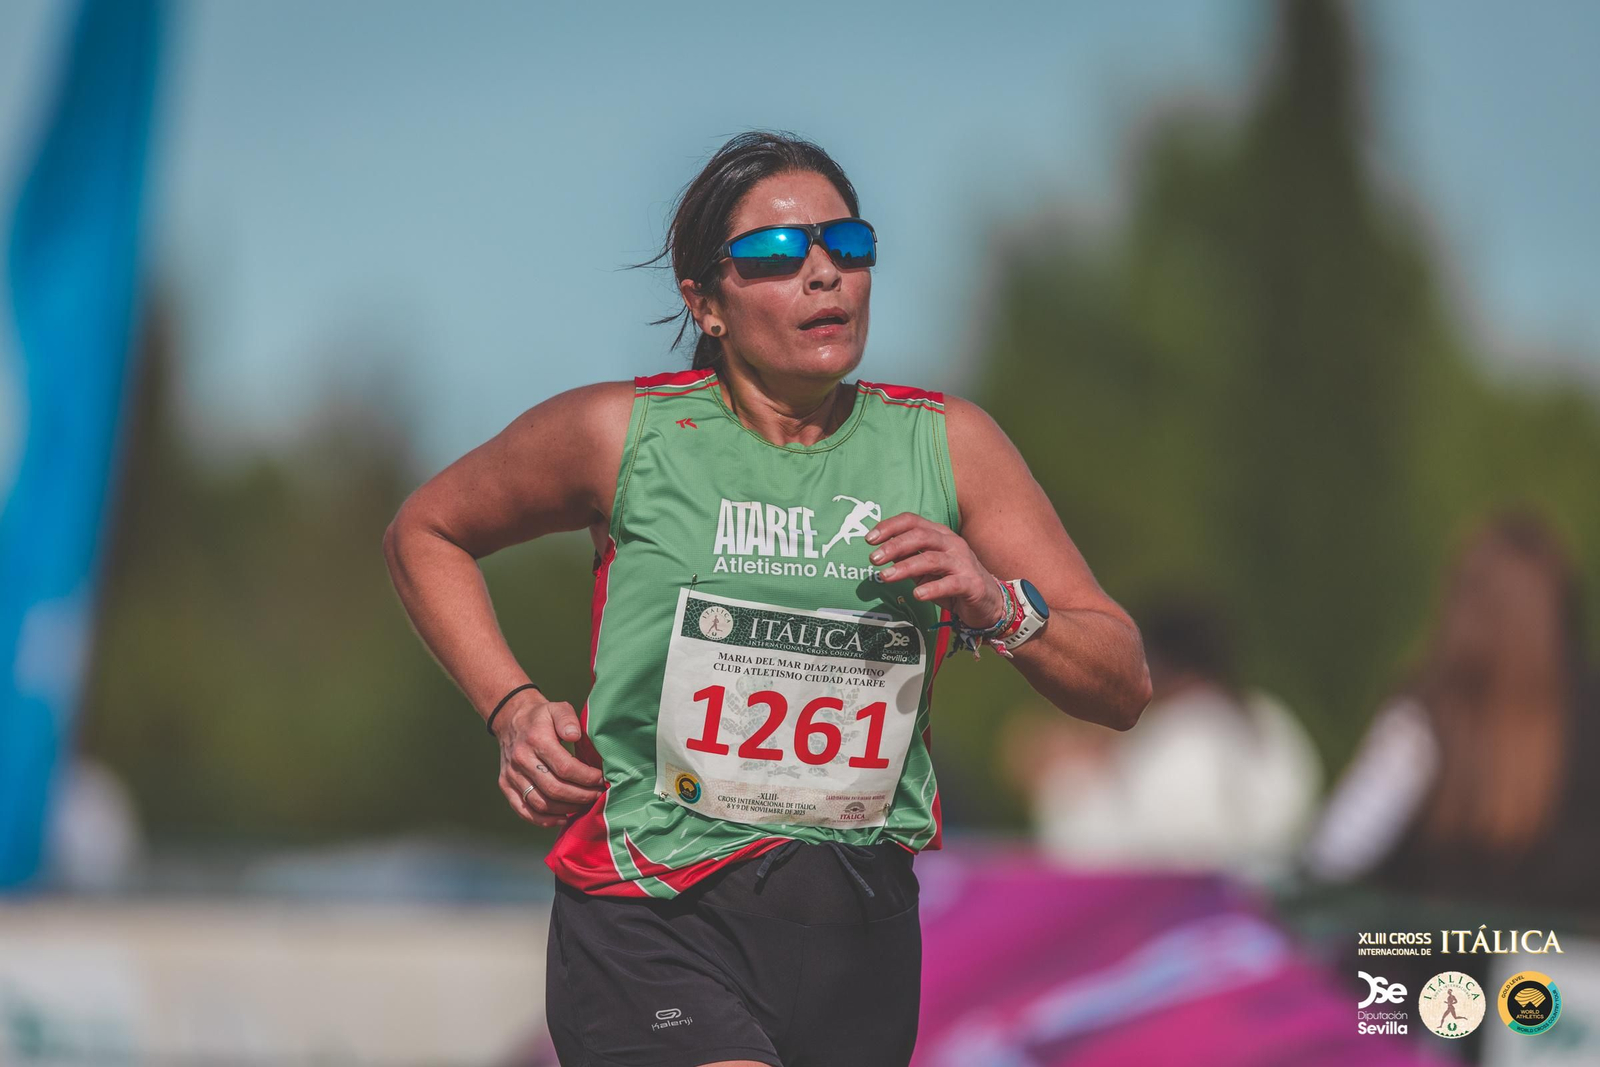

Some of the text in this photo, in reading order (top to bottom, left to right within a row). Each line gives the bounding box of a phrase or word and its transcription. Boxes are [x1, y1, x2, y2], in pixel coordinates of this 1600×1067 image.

[713, 498, 819, 558] ATARFE
[713, 556, 817, 577] Atletismo
[749, 616, 864, 652] ITÁLICA
[748, 640, 804, 652] INTERNATIONAL
[830, 650, 864, 658] COUNTRY
[881, 653, 908, 662] Sevilla
[713, 662, 886, 688] CLUB ATLETISMO CIUDAD ATARFE
[718, 652, 885, 678] MARIA DEL MAR DIAZ PALOMINO
[686, 684, 889, 769] 1261
[717, 795, 737, 803] CROSS
[737, 798, 784, 808] INTERNACIONAL
[749, 805, 783, 815] NOVIEMBRE
[651, 1016, 693, 1031] Kalenji
